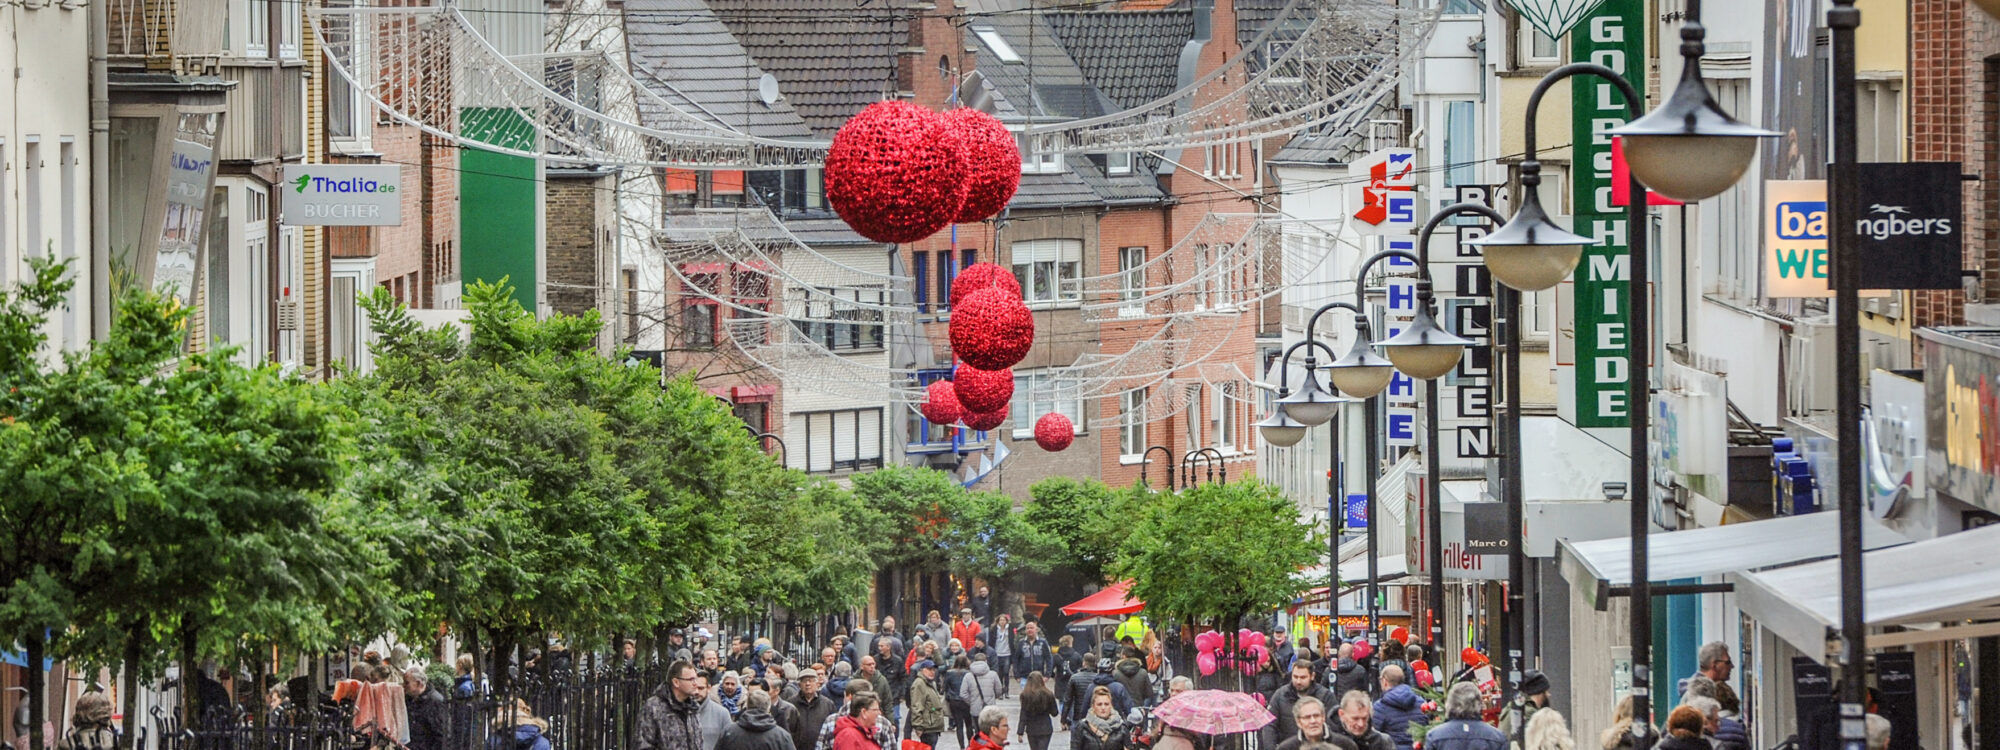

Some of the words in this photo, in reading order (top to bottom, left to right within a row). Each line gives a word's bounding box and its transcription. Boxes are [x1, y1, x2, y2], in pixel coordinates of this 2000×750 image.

[1856, 213, 1951, 240] ngbers
[1389, 198, 1413, 439] SCHHE
[1460, 187, 1489, 456] BRILLEN
[1443, 542, 1482, 570] rillen
